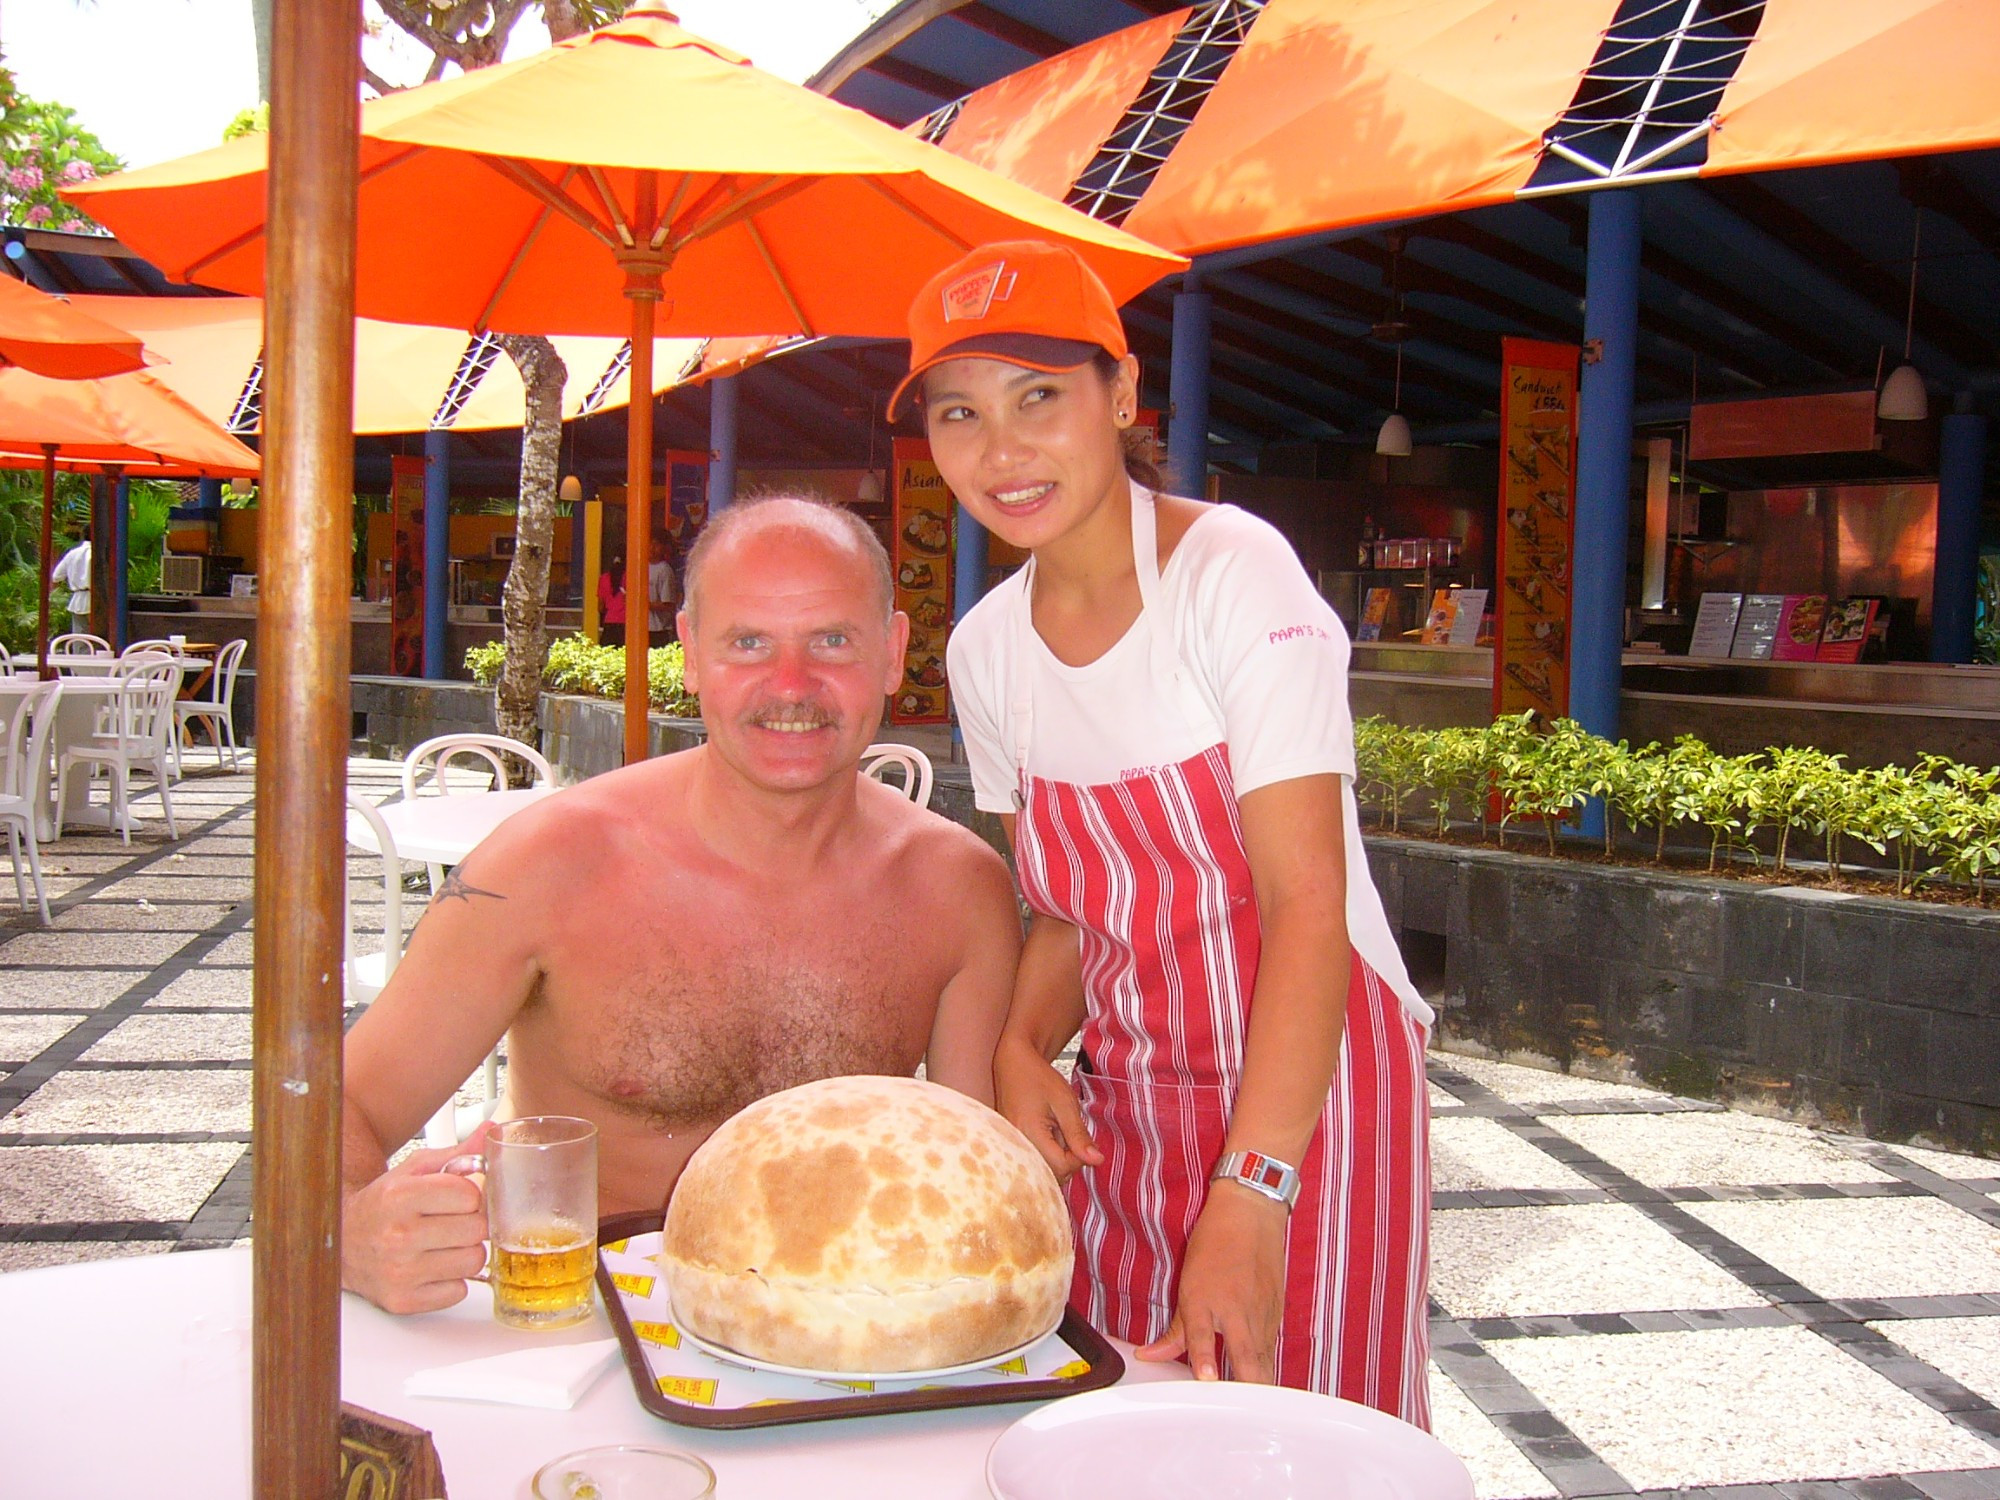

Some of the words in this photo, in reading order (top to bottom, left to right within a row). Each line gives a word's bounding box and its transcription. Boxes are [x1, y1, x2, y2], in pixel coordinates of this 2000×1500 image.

[903, 467, 944, 490] Asian
[1269, 624, 1313, 645] PAPA'S
[1120, 765, 1157, 781] PAPA'S
